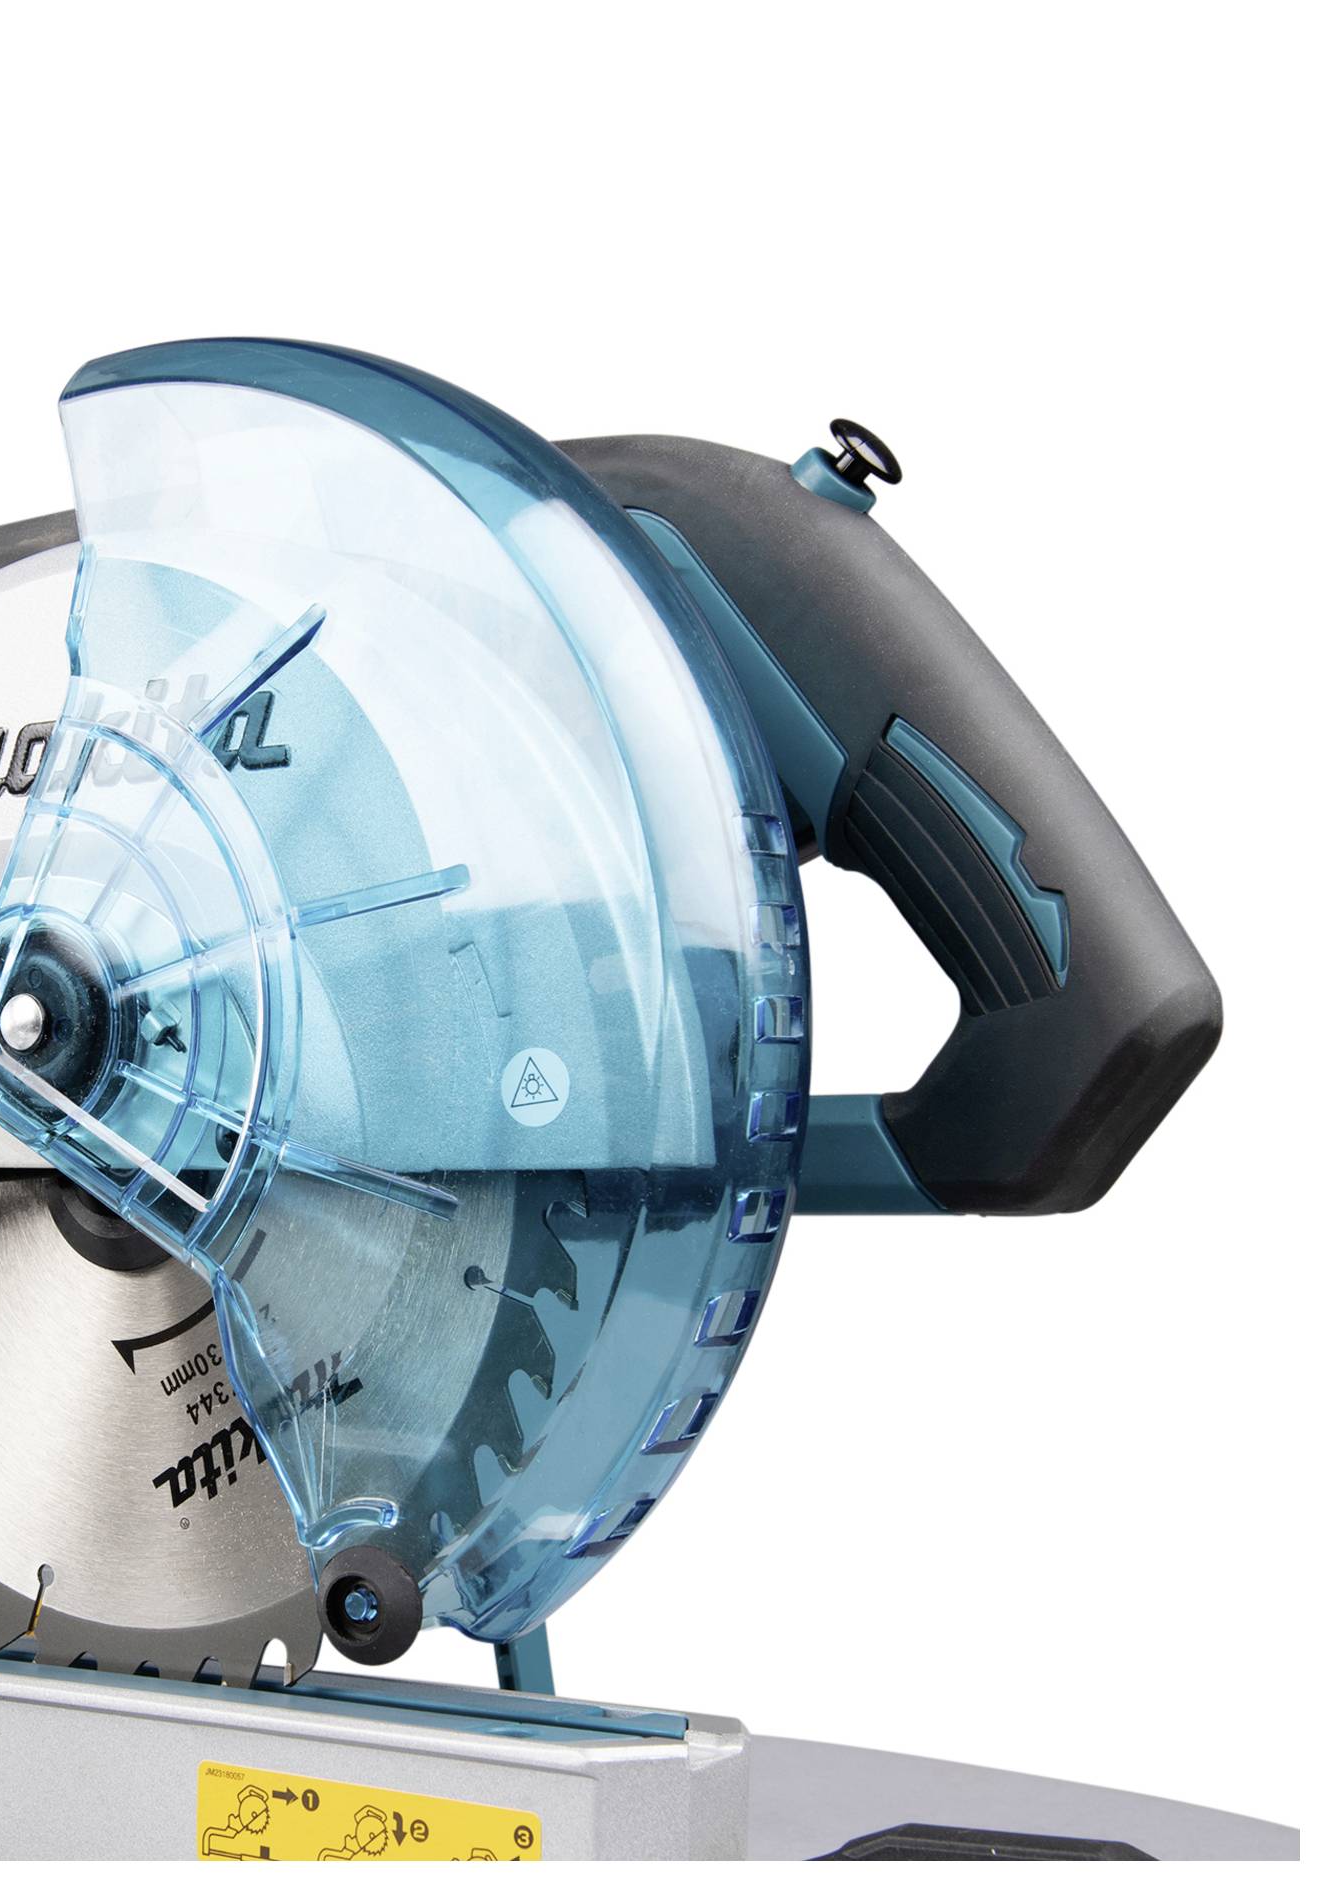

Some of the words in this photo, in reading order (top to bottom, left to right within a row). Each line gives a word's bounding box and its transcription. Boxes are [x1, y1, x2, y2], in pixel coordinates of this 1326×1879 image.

[186, 1381, 236, 1426] 344
[412, 1820, 426, 1840] 2
[516, 1827, 531, 1848] 3
